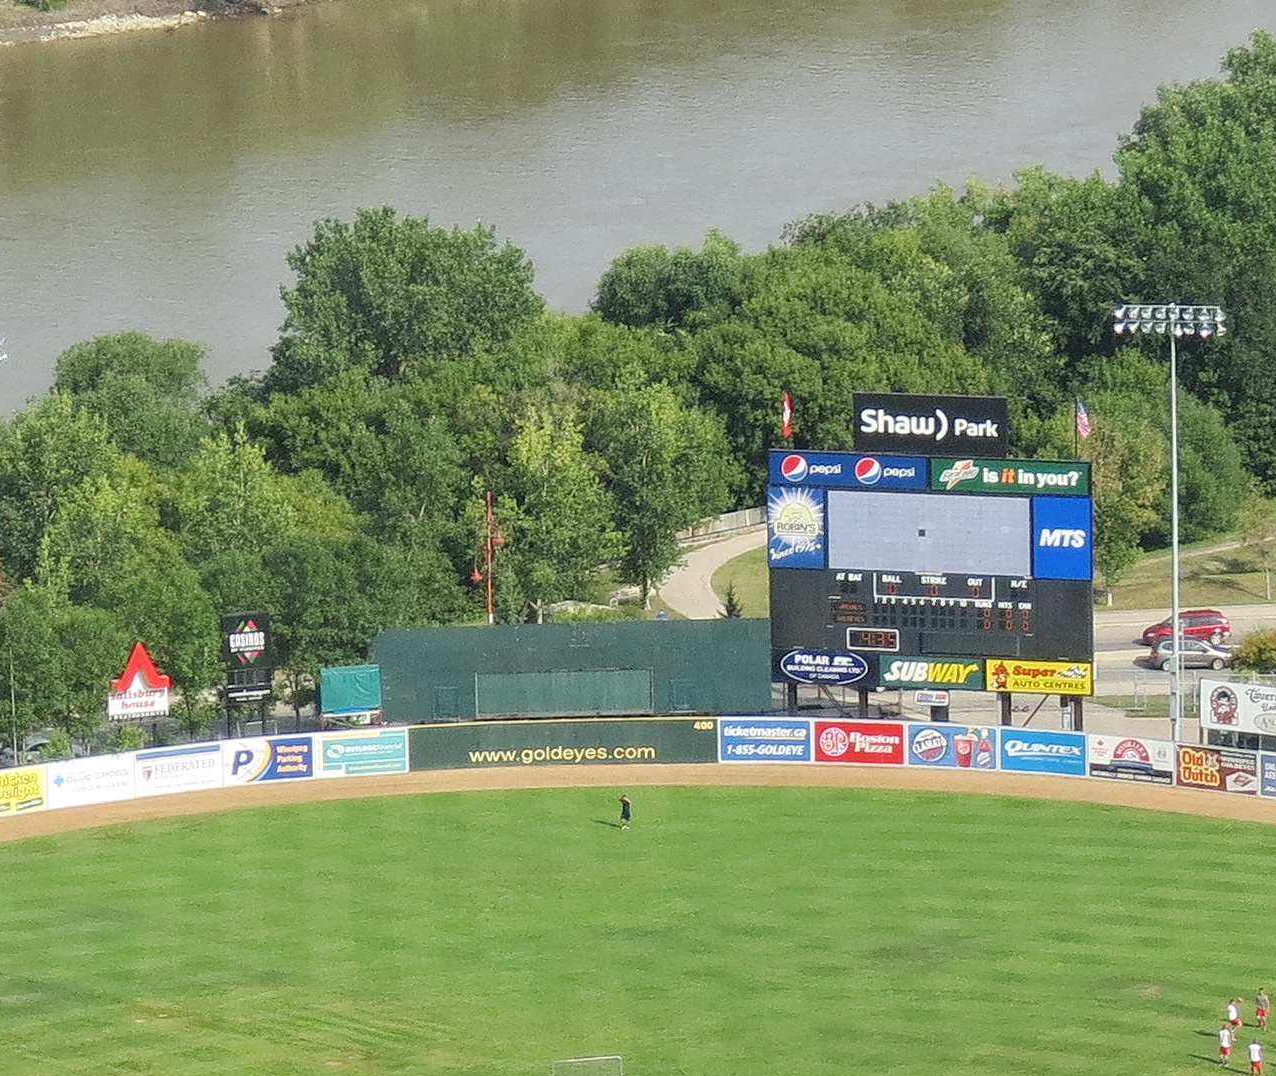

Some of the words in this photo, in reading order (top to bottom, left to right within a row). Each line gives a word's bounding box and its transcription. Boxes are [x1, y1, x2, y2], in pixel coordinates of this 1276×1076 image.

[954, 417, 999, 438] Park
[809, 463, 842, 475] pepsi
[882, 466, 916, 478] pepsi
[982, 467, 998, 483] is
[1001, 467, 1016, 483] it
[1018, 467, 1034, 484] in
[1036, 470, 1080, 488] you?
[1039, 529, 1087, 548] MTS
[882, 574, 902, 583] BALL
[921, 576, 947, 585] STRIKE
[967, 578, 983, 586] OUT
[229, 632, 265, 648] CASINOS
[794, 654, 829, 665] POLAR
[883, 660, 980, 684] SUBWAY
[1013, 665, 1057, 679] Super
[1013, 680, 1040, 688] AUTO
[1043, 681, 1085, 690] CENTRES
[121, 700, 156, 710] house
[693, 720, 714, 730] 400
[723, 725, 807, 739] ticketmaster.ca
[849, 731, 900, 745] Boston
[469, 745, 656, 764] www.goldeyes.com
[726, 743, 805, 756] 1-855-GOLDEYE
[853, 742, 893, 753] Pizza
[1004, 739, 1084, 757] QUINTEX
[231, 750, 254, 776] P
[1182, 750, 1204, 767] Old
[154, 758, 216, 774] FEDERATED
[94, 769, 130, 780] CROSS
[1182, 767, 1219, 784] Dutch
